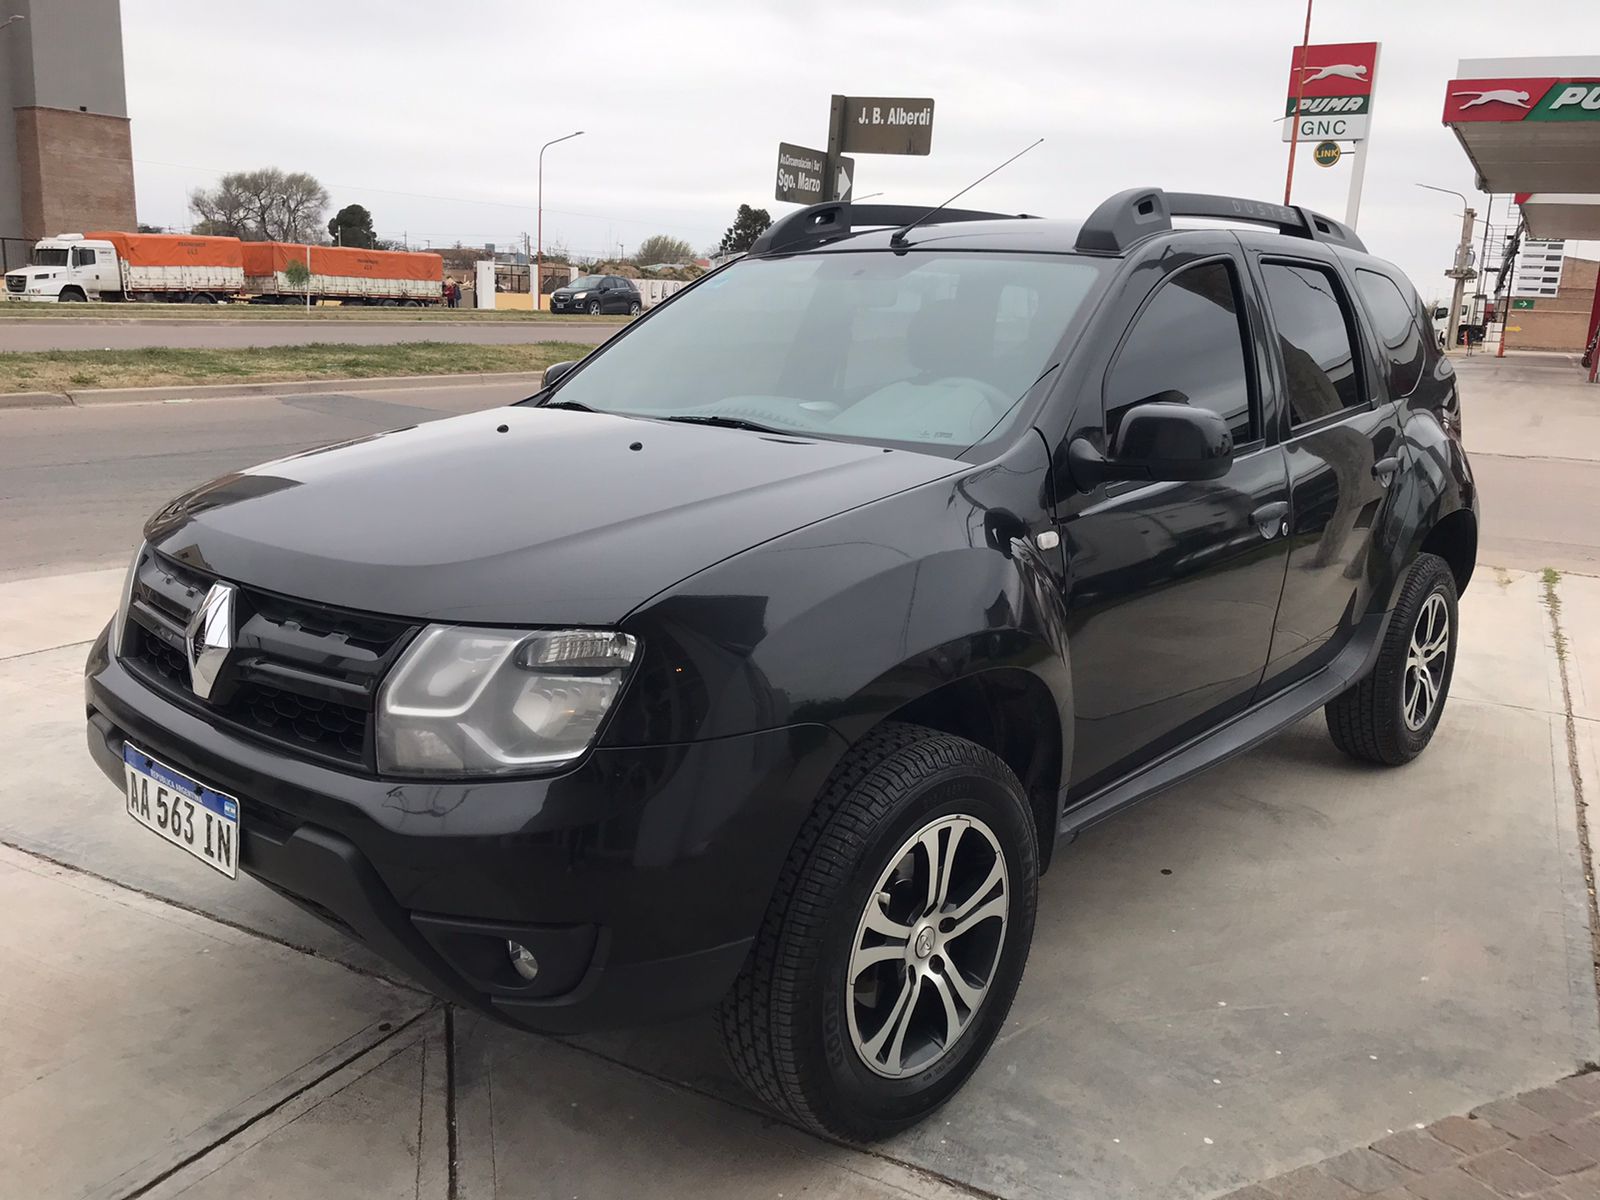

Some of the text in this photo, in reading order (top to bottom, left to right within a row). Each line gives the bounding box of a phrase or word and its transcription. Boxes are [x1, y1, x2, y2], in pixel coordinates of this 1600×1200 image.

[1291, 97, 1364, 113] PUMA
[858, 107, 930, 126] J. B. Alberdi
[1301, 120, 1347, 136] GNC
[1316, 148, 1339, 158] LINK
[778, 168, 821, 193] Sgo. Marzo
[1232, 200, 1299, 223] DUSTER
[130, 771, 231, 868] AA 563 IN
